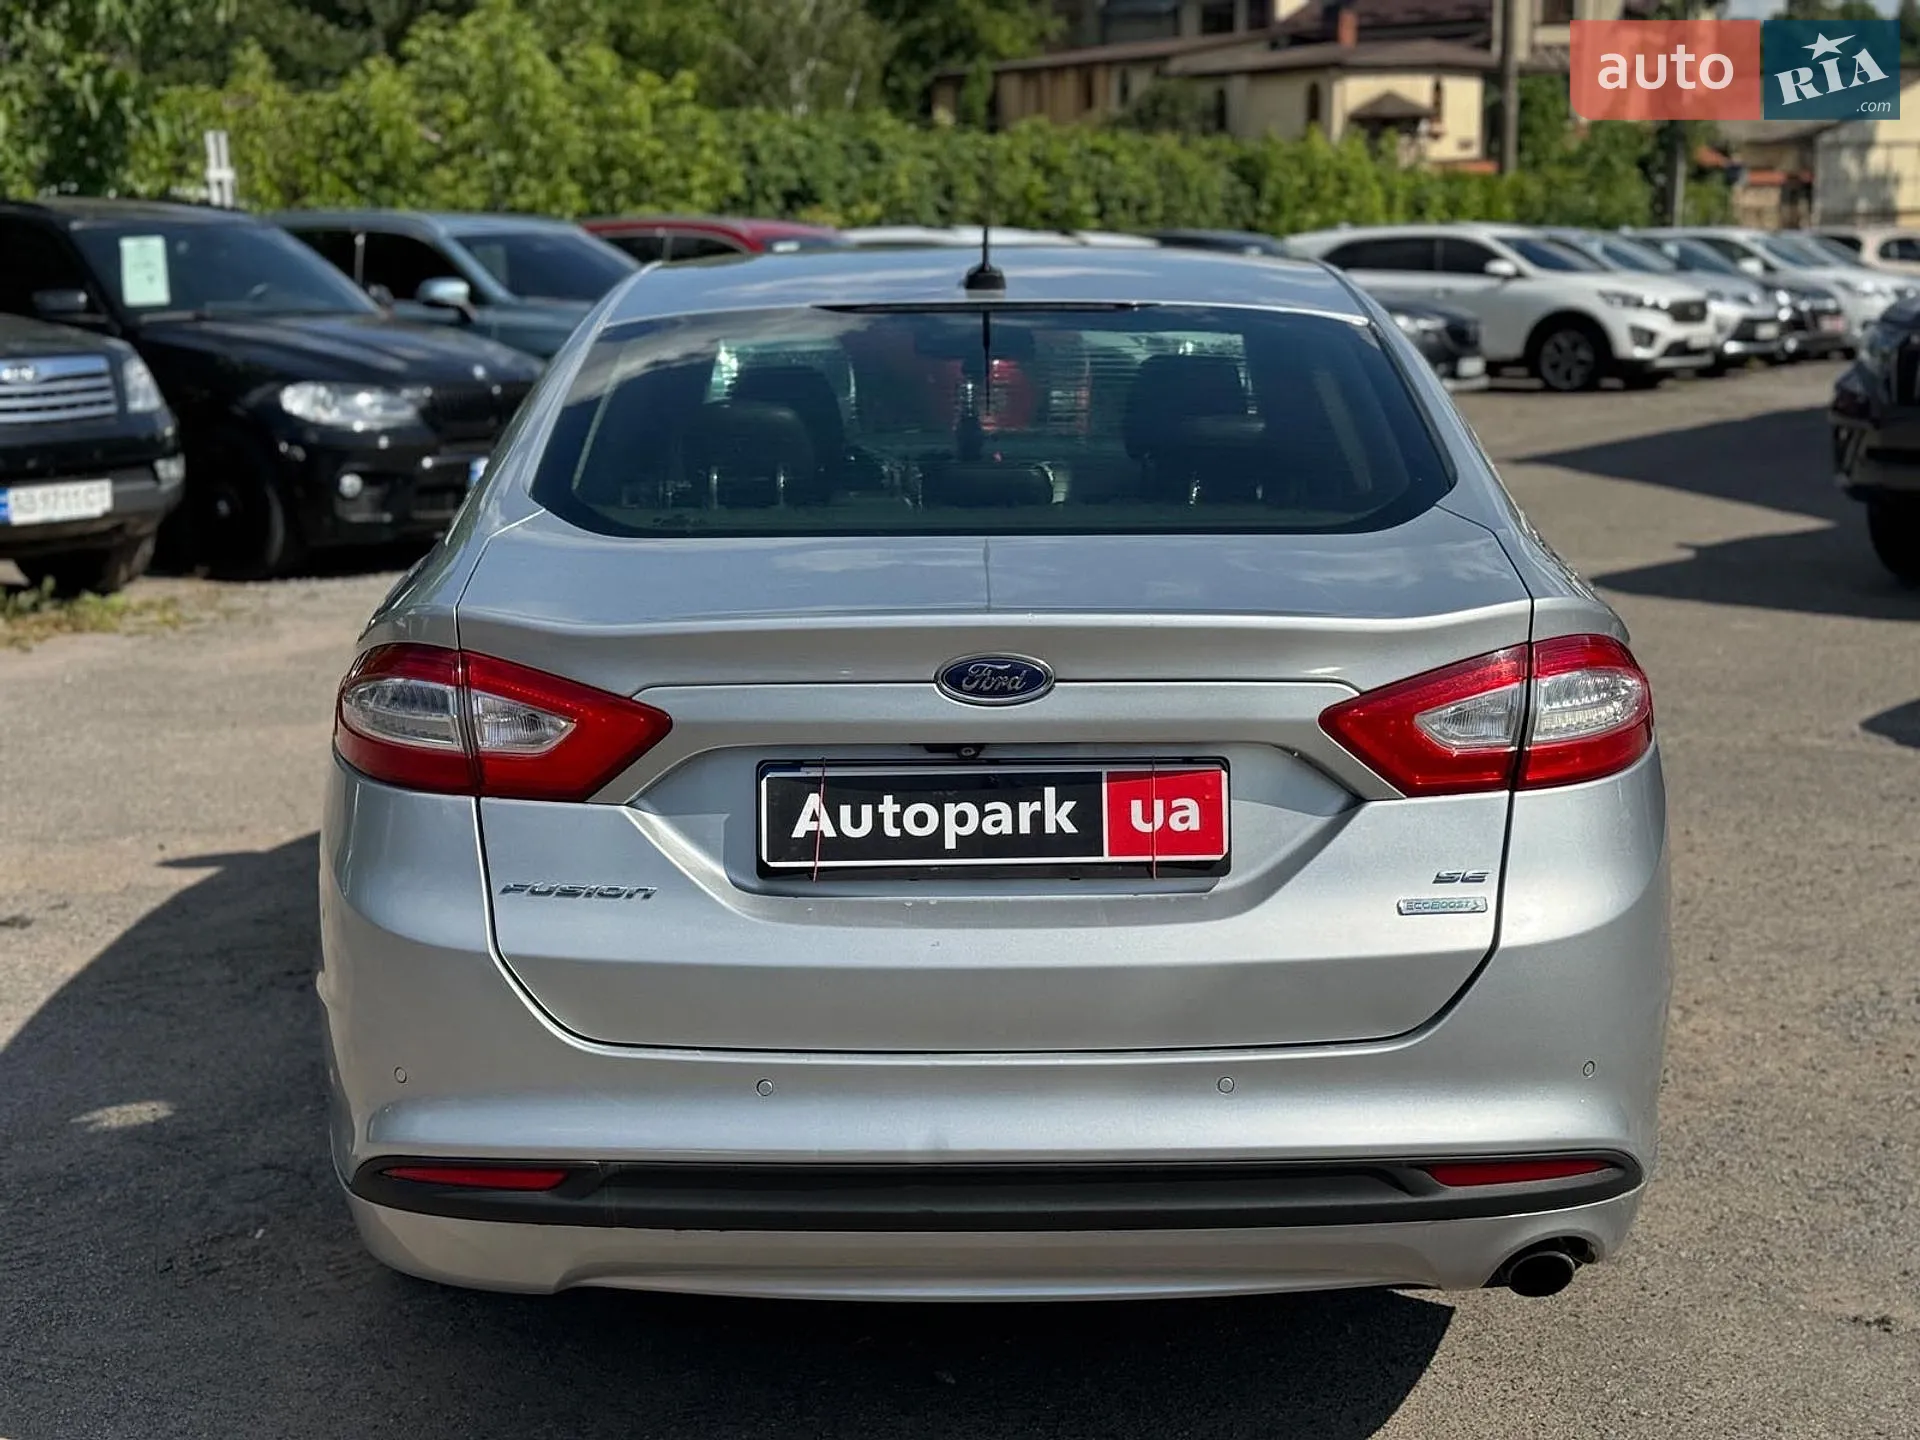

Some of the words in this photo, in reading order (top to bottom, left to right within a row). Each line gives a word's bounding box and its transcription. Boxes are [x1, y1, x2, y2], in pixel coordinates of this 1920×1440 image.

[961, 663, 1028, 692] Ford
[791, 786, 1079, 849] Autopark
[1130, 797, 1201, 833] ua
[1431, 870, 1490, 885] SE
[499, 882, 658, 900] FUSION
[1406, 900, 1470, 911] ECOBOOST
